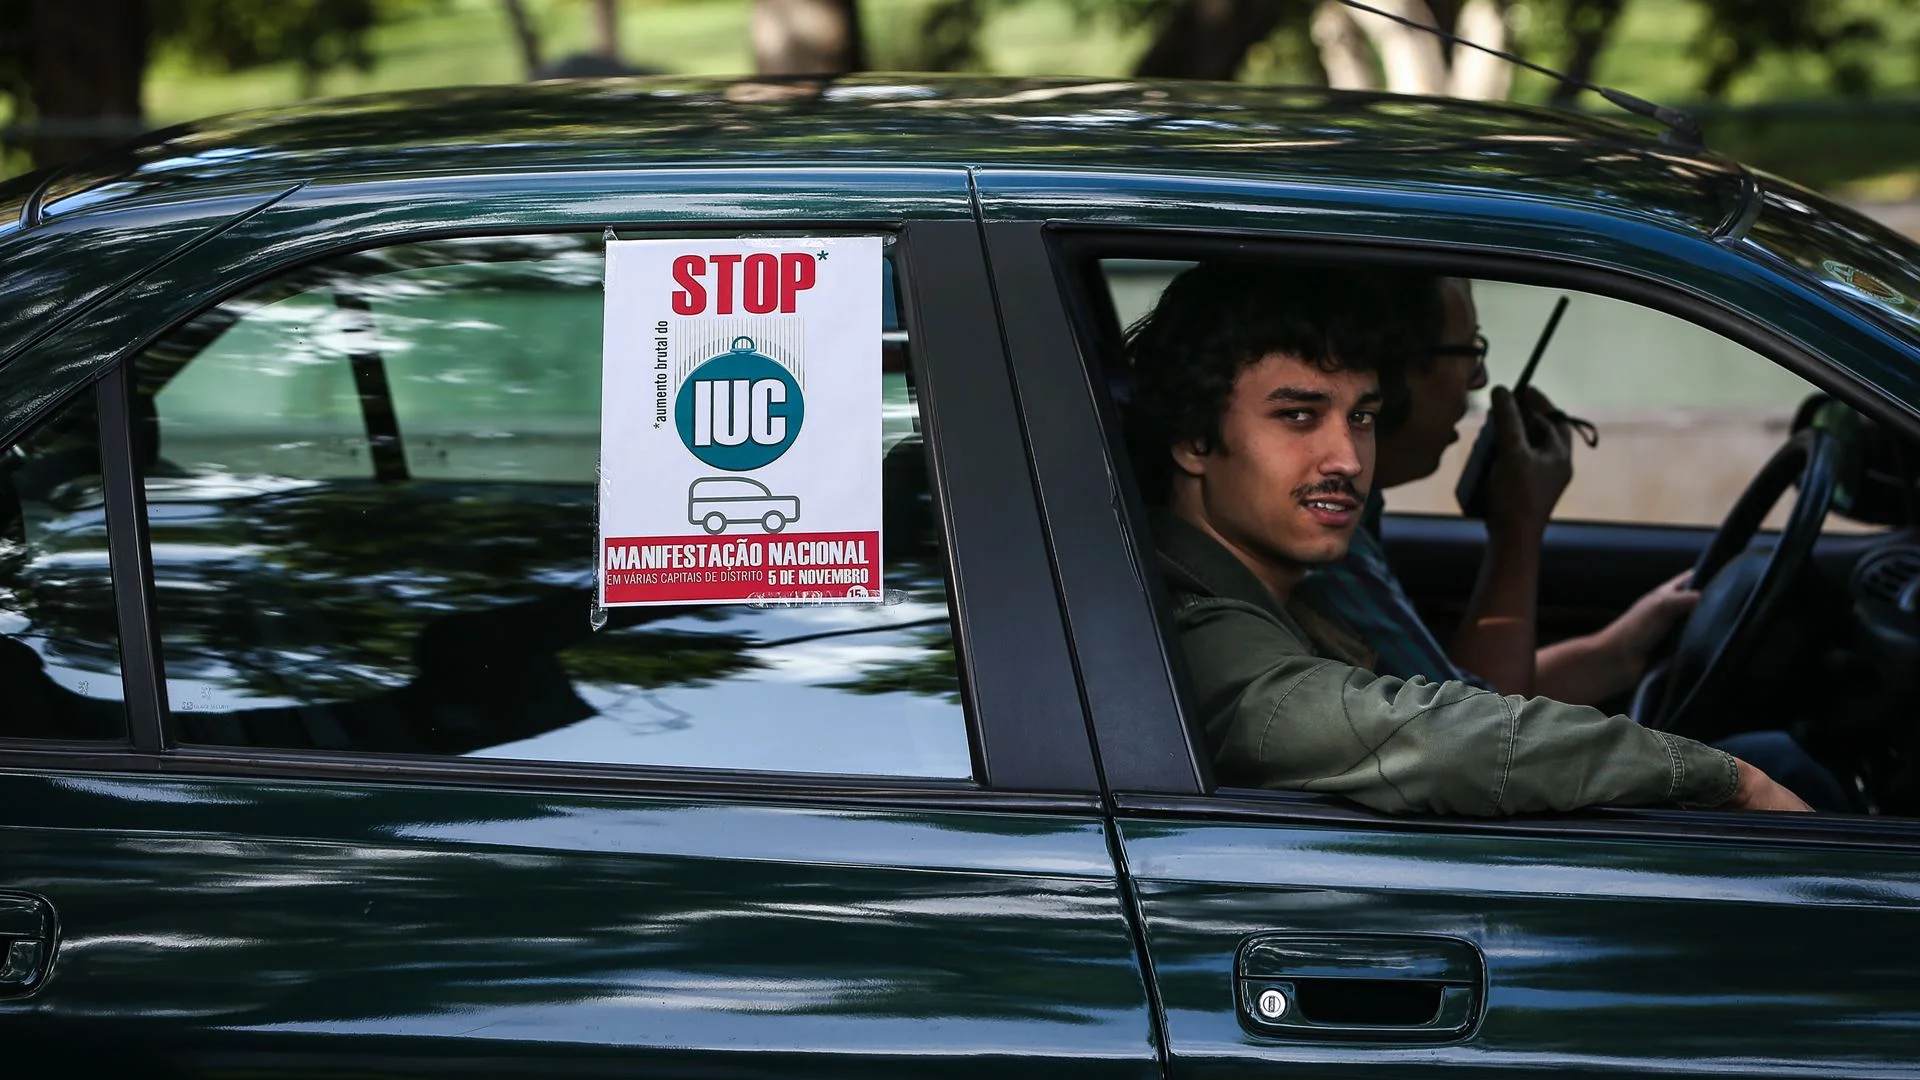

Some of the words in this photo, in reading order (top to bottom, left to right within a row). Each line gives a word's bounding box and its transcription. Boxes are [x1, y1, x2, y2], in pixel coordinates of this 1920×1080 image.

[655, 320, 669, 334] do
[654, 337, 668, 370] brutal
[692, 378, 788, 448] IUC
[607, 538, 763, 571] MANIFESTAÇÃO
[768, 540, 869, 567] NACIONAL
[607, 573, 621, 586] EM
[623, 571, 658, 585] VÁRIAS
[660, 571, 702, 584] CAPITAIS
[705, 571, 718, 583] DE
[720, 569, 763, 582] DISTRITO
[768, 570, 776, 586] 5
[780, 569, 796, 585] DE
[798, 568, 869, 585] NOVEMBRO
